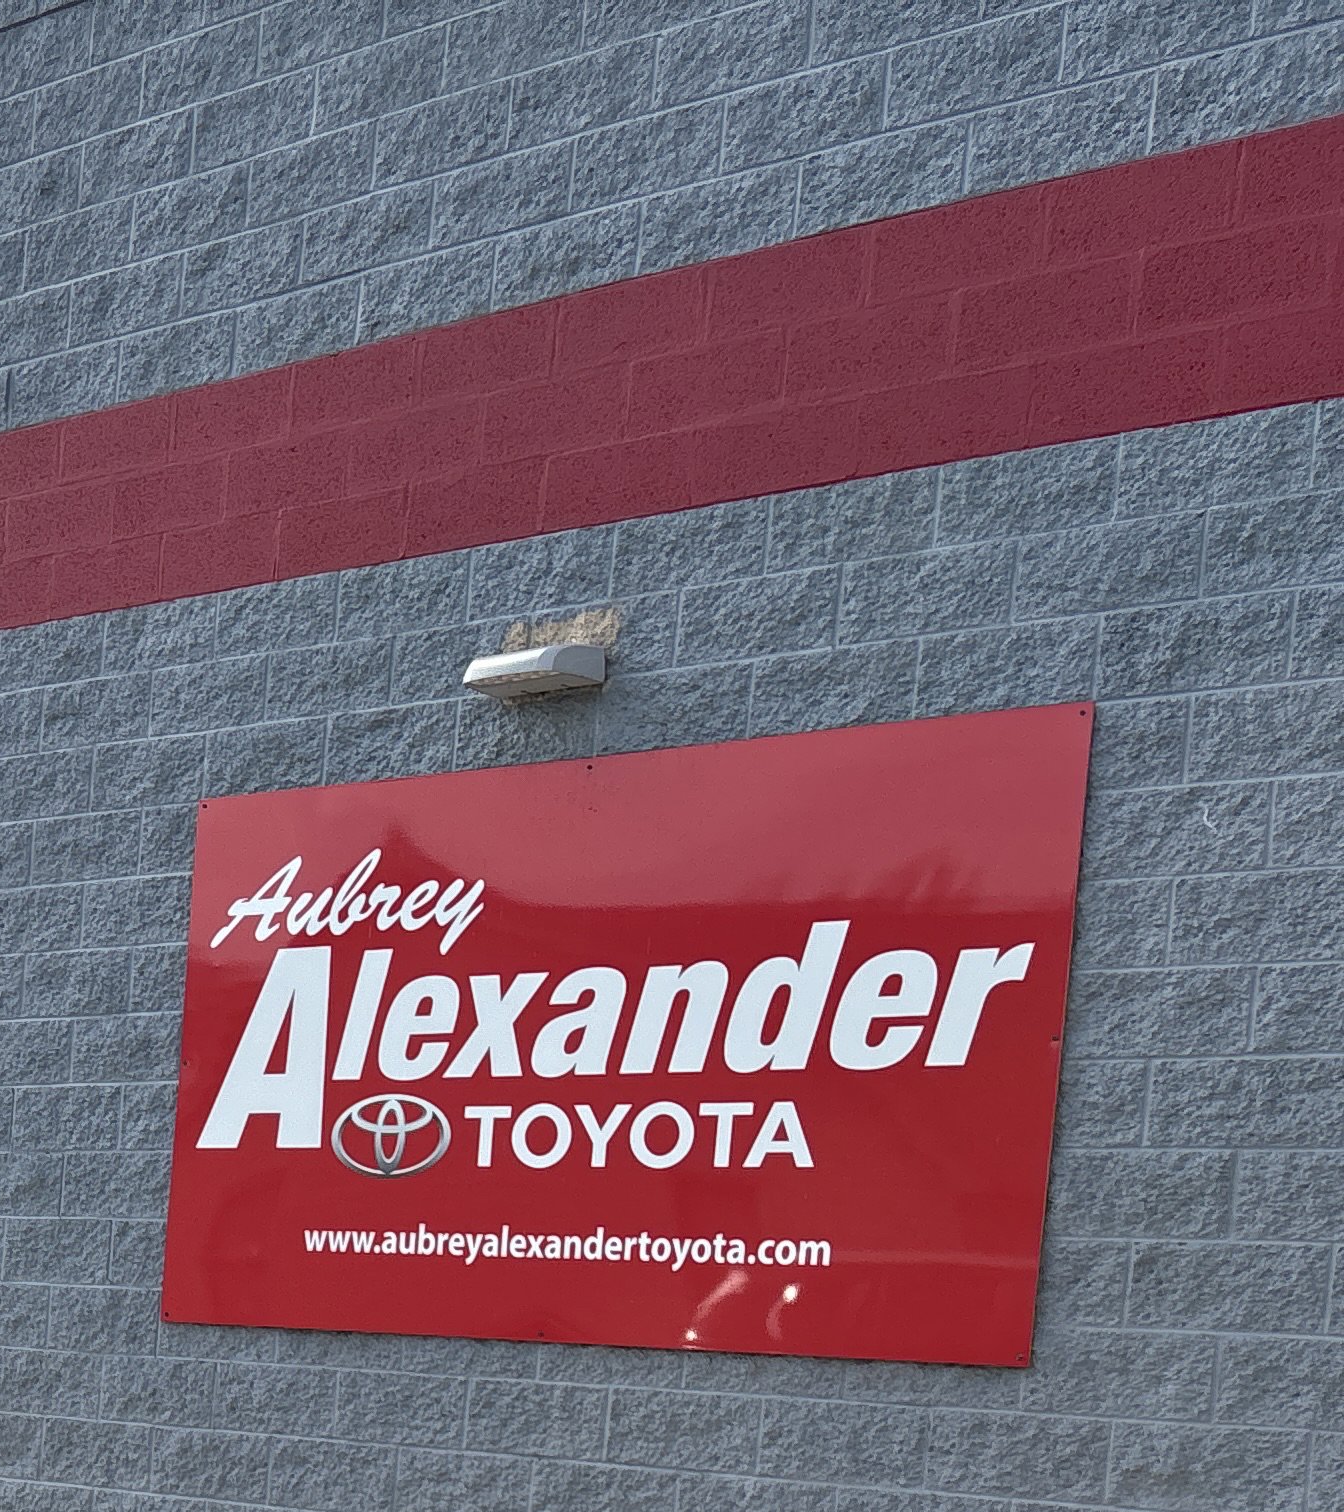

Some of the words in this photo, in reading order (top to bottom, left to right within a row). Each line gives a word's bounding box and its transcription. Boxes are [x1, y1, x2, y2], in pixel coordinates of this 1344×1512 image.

[209, 847, 486, 957] Aubrey
[195, 919, 1035, 1149] Alexander
[463, 1100, 816, 1169] TOYOTA
[303, 1223, 832, 1272] www.aubreyalexandertoyota.com
